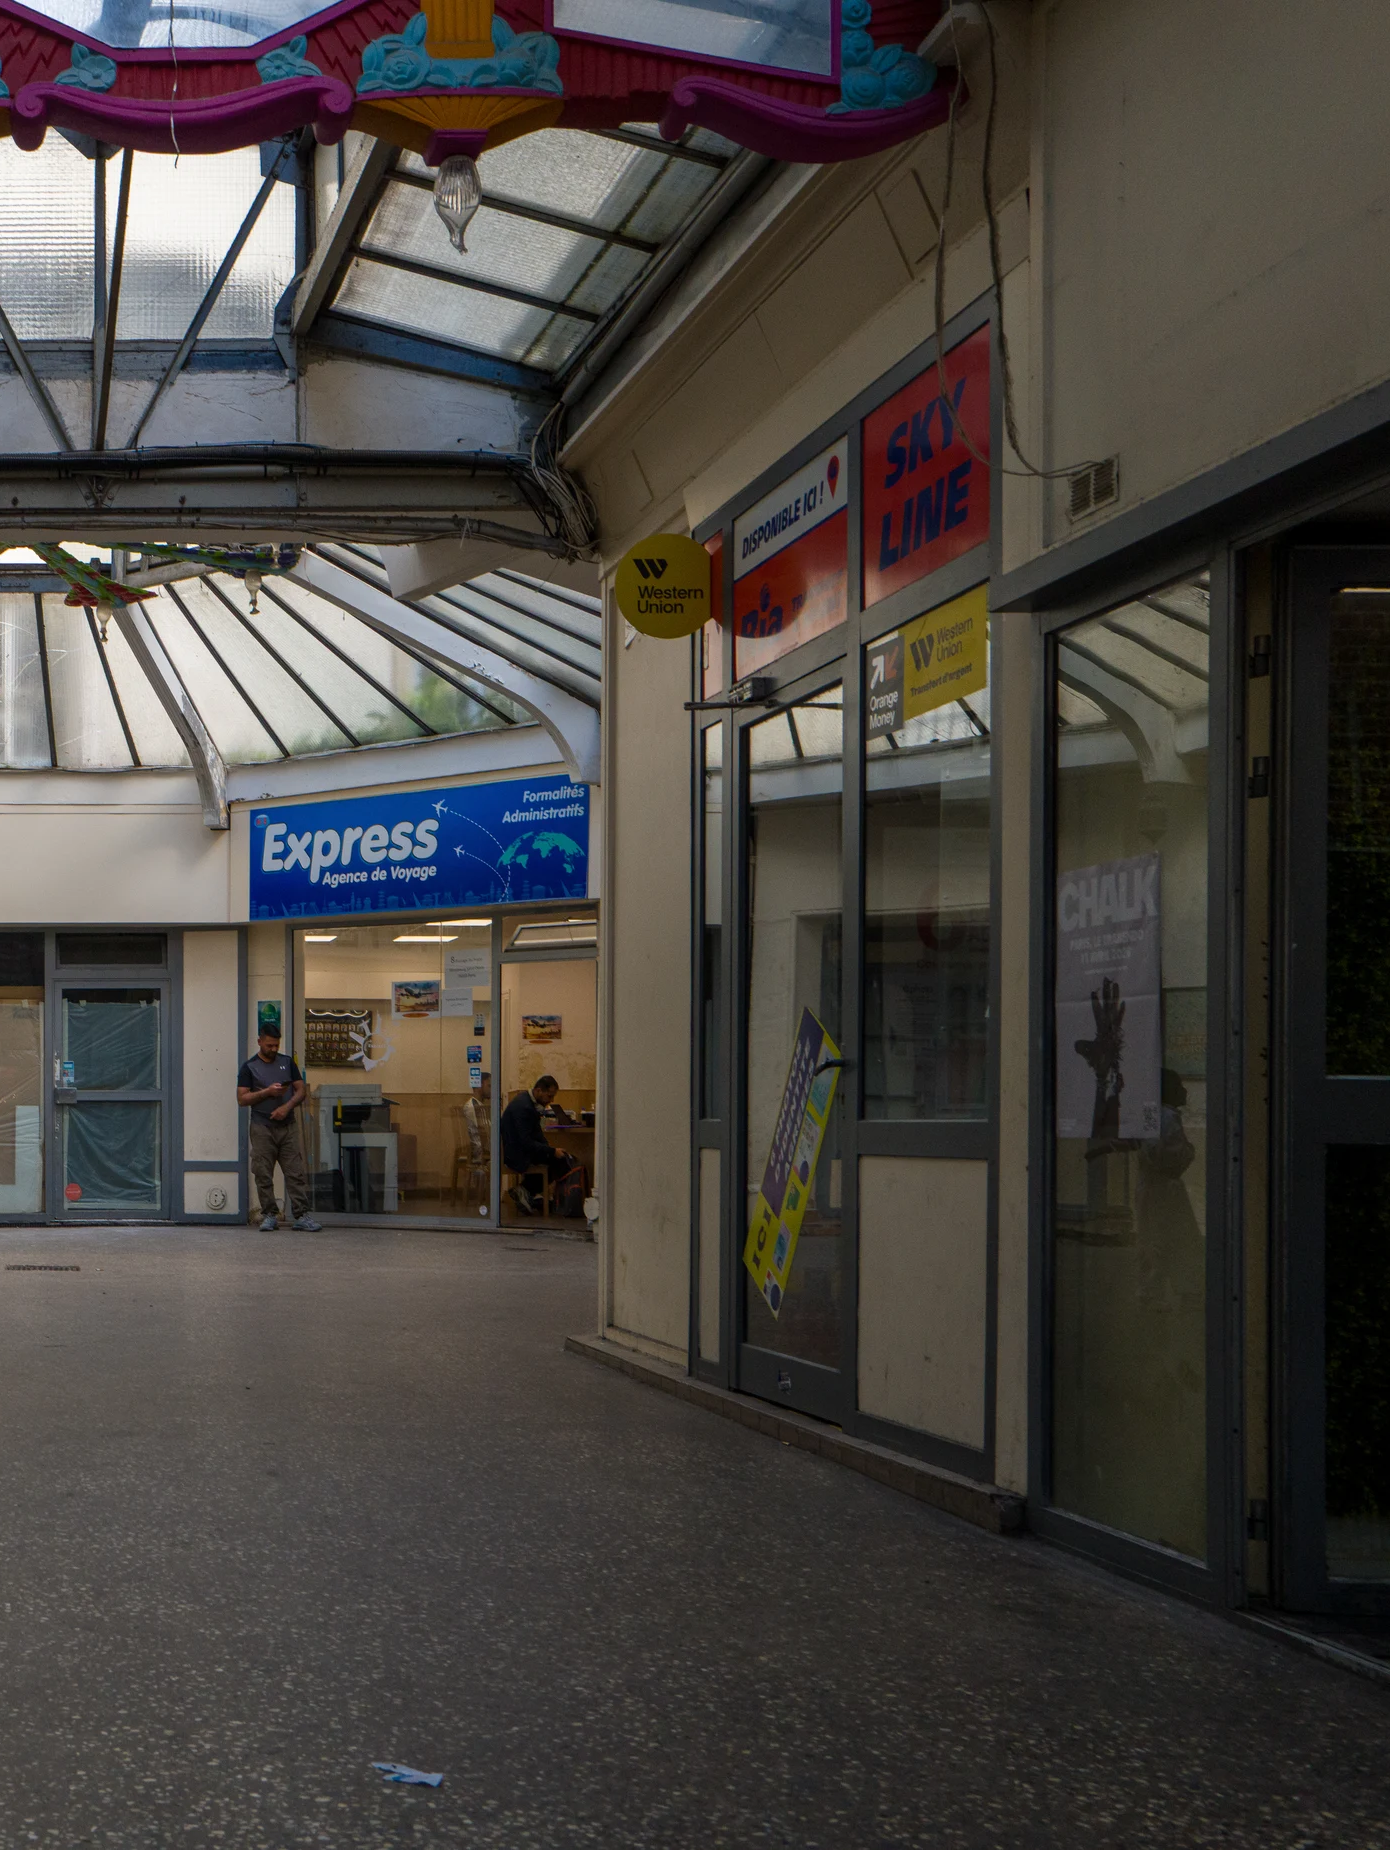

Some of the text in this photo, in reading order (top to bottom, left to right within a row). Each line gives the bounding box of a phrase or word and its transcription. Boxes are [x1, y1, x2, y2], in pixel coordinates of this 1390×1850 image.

[883, 377, 967, 490] SKY
[741, 498, 801, 560] DISPONIBLE
[803, 485, 817, 513] ICI
[878, 458, 973, 572] LINE
[637, 586, 704, 600] Western
[637, 601, 684, 614] Union
[935, 617, 973, 645] Western
[936, 641, 963, 662] Union
[910, 663, 973, 697] Transfert d'argent
[870, 691, 899, 711] Orange
[869, 711, 896, 730] Money
[522, 785, 585, 804] Formalités
[502, 804, 586, 824] Administratifs
[262, 819, 440, 884] Express
[321, 864, 438, 889] Agence de Voyage
[1059, 865, 1158, 932] CHALK
[751, 1208, 772, 1271] ICI
